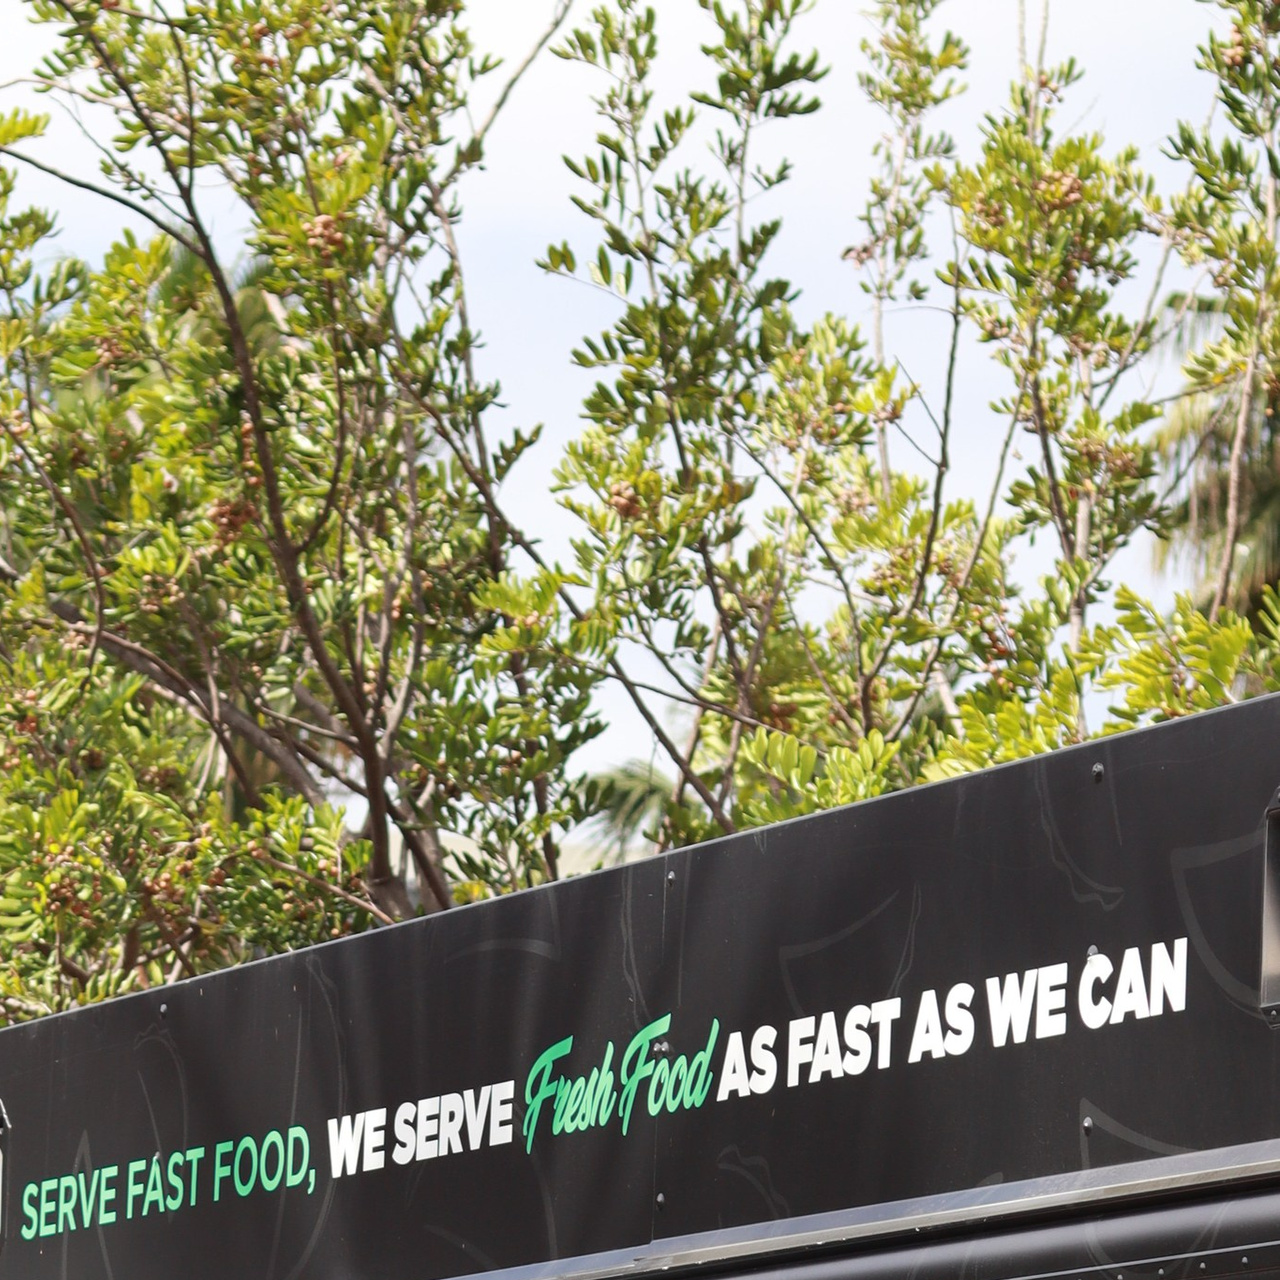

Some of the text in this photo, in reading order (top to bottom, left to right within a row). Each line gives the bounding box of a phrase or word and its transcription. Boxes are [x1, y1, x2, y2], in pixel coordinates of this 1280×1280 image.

[21, 1164, 117, 1241] SERVE
[126, 1146, 206, 1219] FAST
[213, 1125, 316, 1202] FOOD,
[327, 1107, 388, 1179] WE
[392, 1079, 515, 1166] SERVE
[523, 1035, 618, 1154] Fresh
[620, 1013, 720, 1136] Food
[716, 1023, 778, 1102] AS
[786, 997, 901, 1087] FAST
[909, 983, 978, 1065] AS
[986, 962, 1069, 1049] WE
[1078, 937, 1188, 1031] CAN
